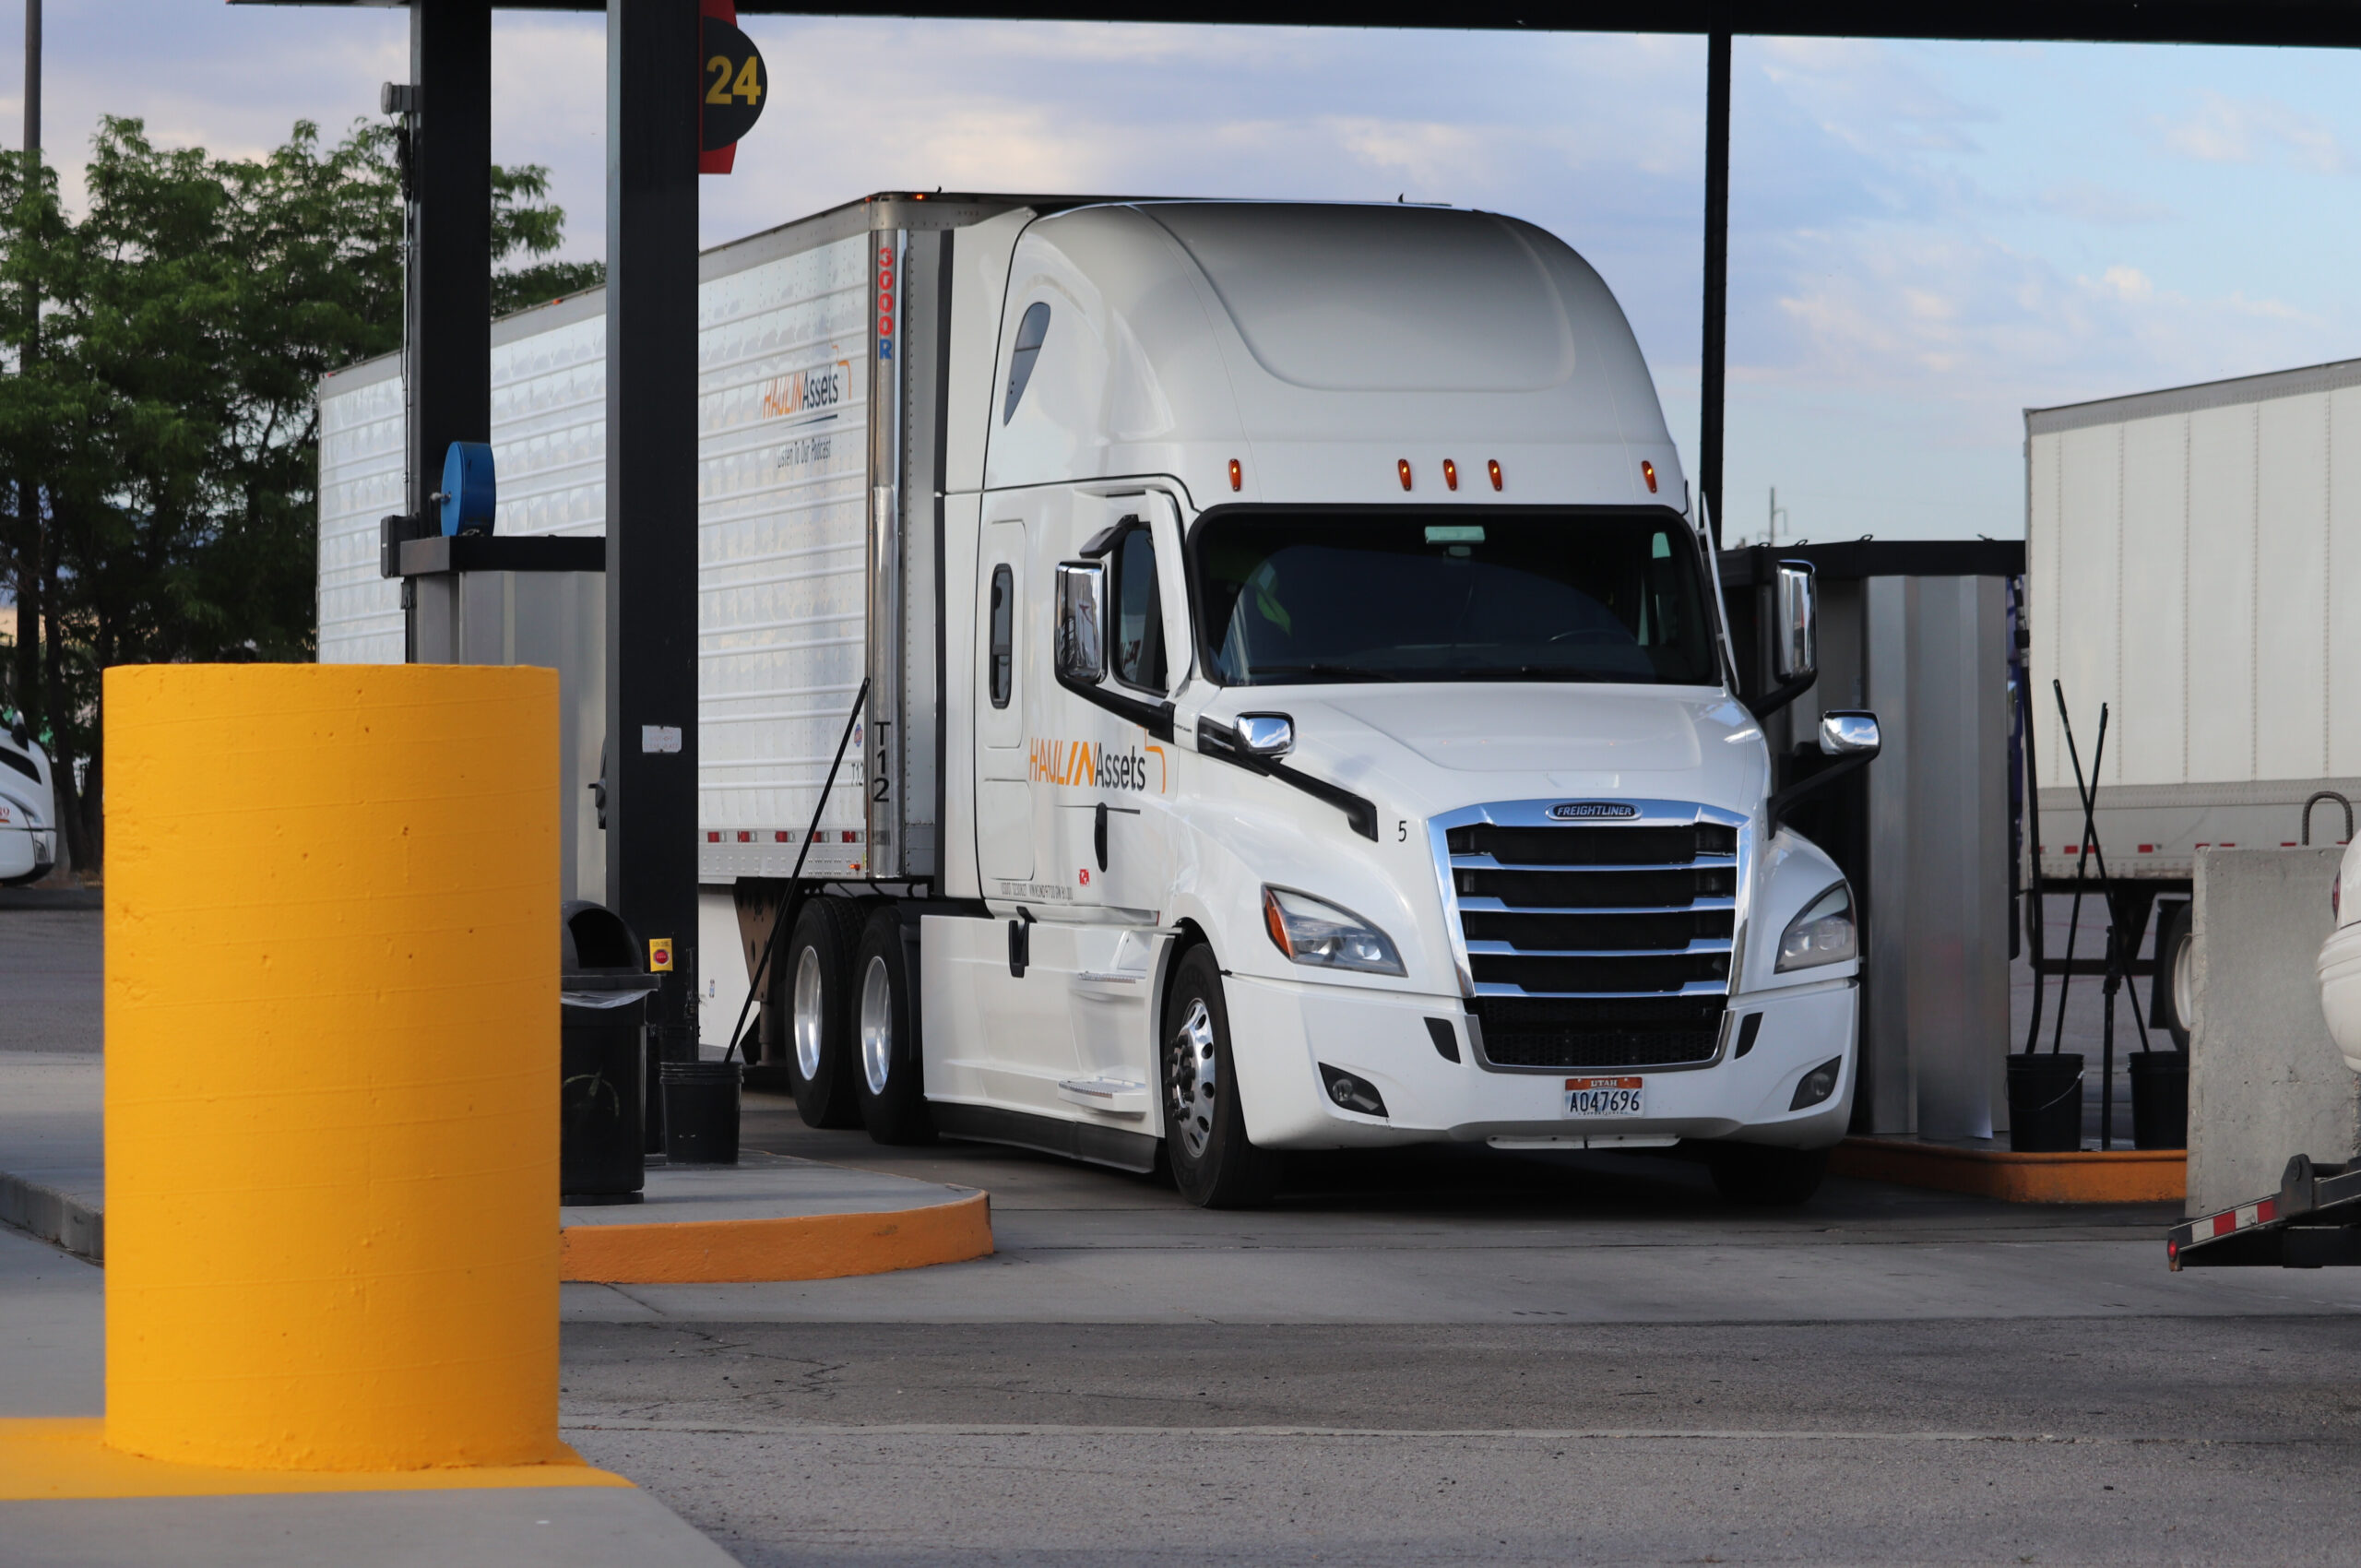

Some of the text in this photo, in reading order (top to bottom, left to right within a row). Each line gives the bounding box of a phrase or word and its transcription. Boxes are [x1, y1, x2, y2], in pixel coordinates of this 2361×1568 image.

[705, 55, 762, 105] 24
[801, 439, 810, 463] Our
[811, 435, 832, 463] Podcast
[1556, 804, 1635, 817] FREIGHTLINER
[1397, 820, 1407, 842] 5
[1590, 1079, 1618, 1087] UTAH
[1570, 1090, 1640, 1112] A047696
